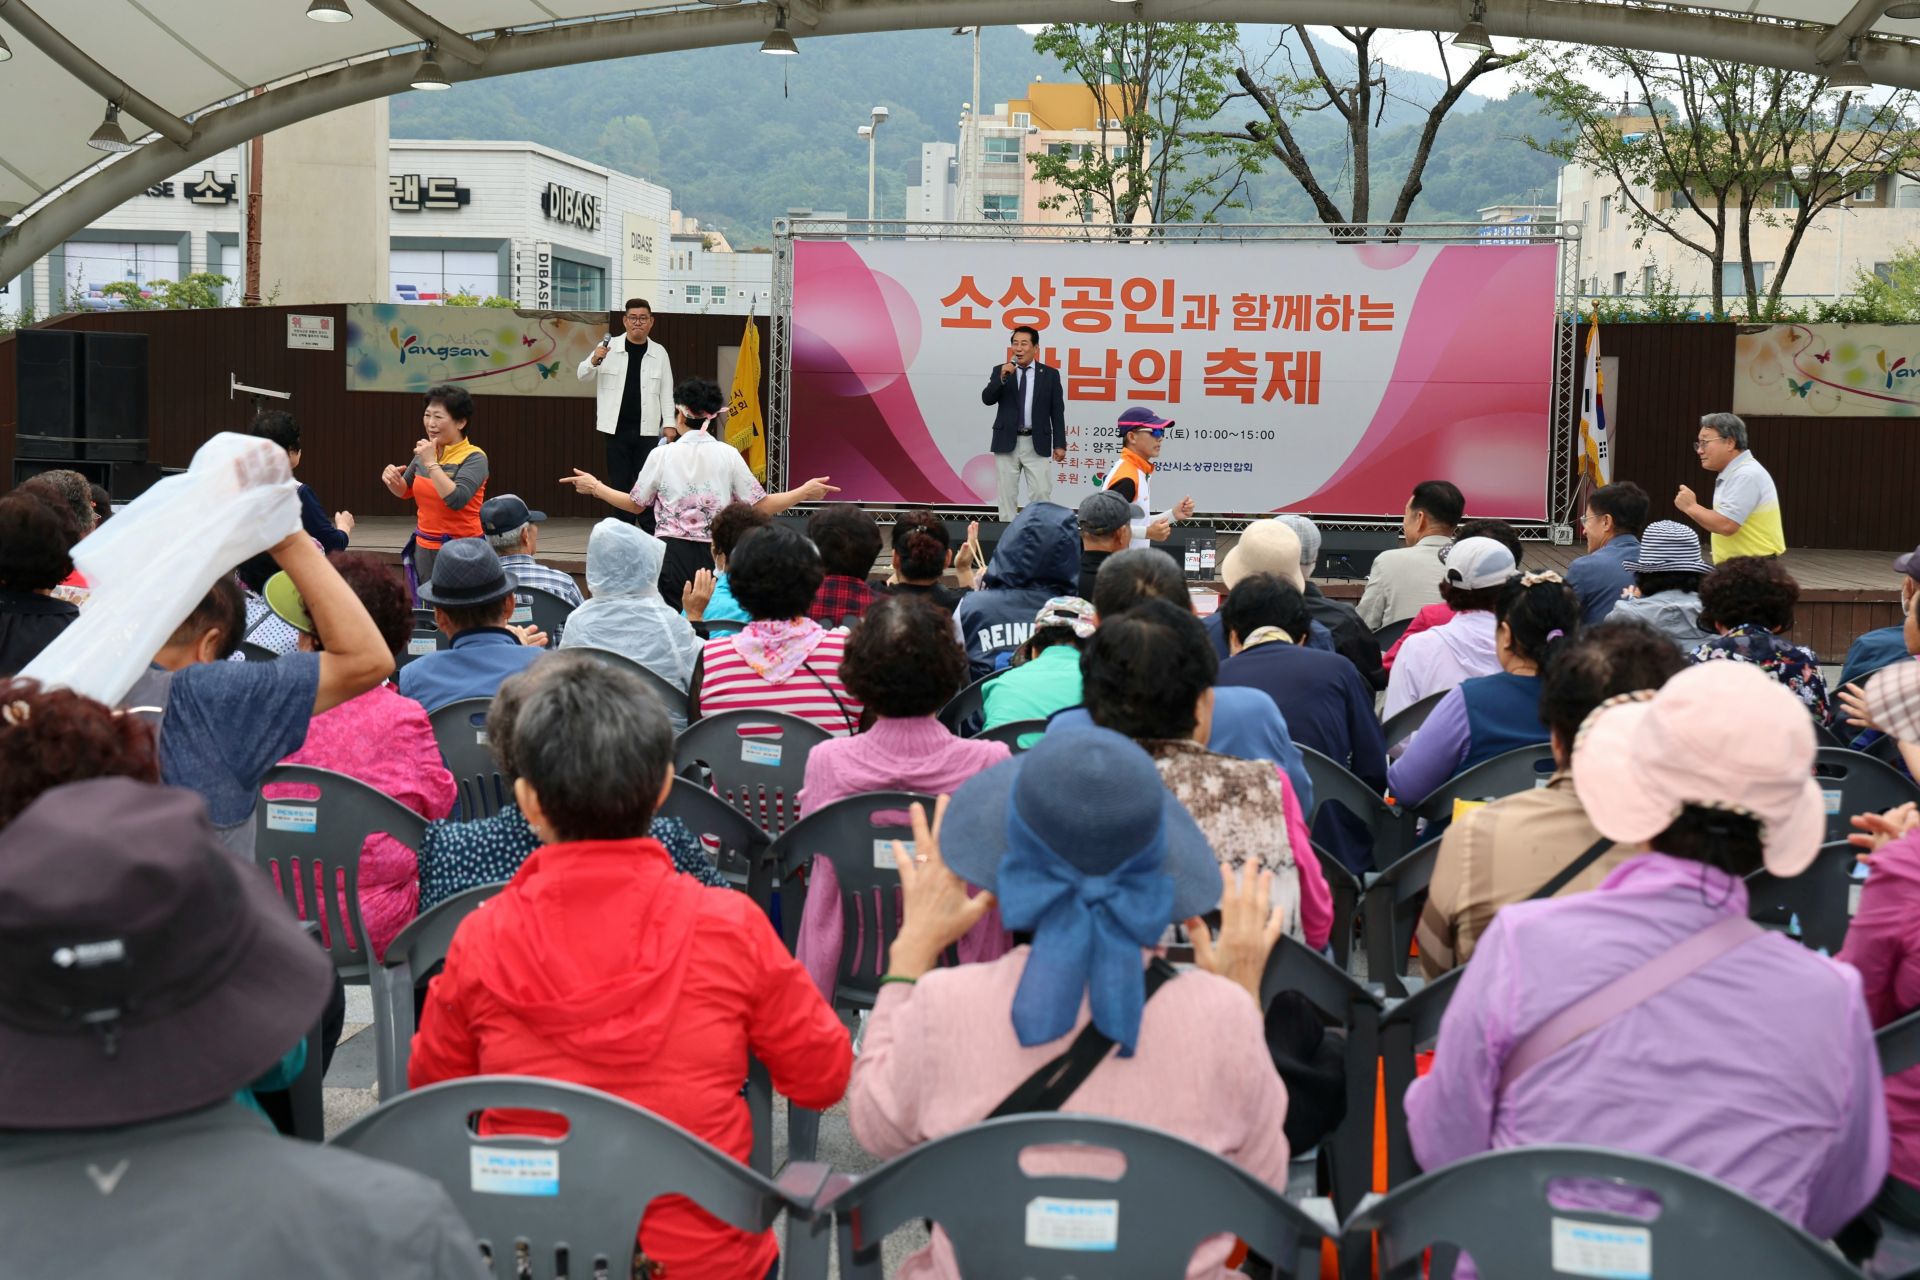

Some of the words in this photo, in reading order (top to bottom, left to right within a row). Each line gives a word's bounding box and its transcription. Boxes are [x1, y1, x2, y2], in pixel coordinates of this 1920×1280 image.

[548, 182, 602, 231] DIBASE
[631, 231, 653, 253] DIBASE
[538, 253, 549, 310] DIBASE
[940, 275, 1220, 334] 소상공인과
[1232, 293, 1395, 333] 함께하는
[390, 327, 490, 365] Yangsan
[1203, 347, 1322, 405] 축제
[1057, 472, 1080, 485] 후원
